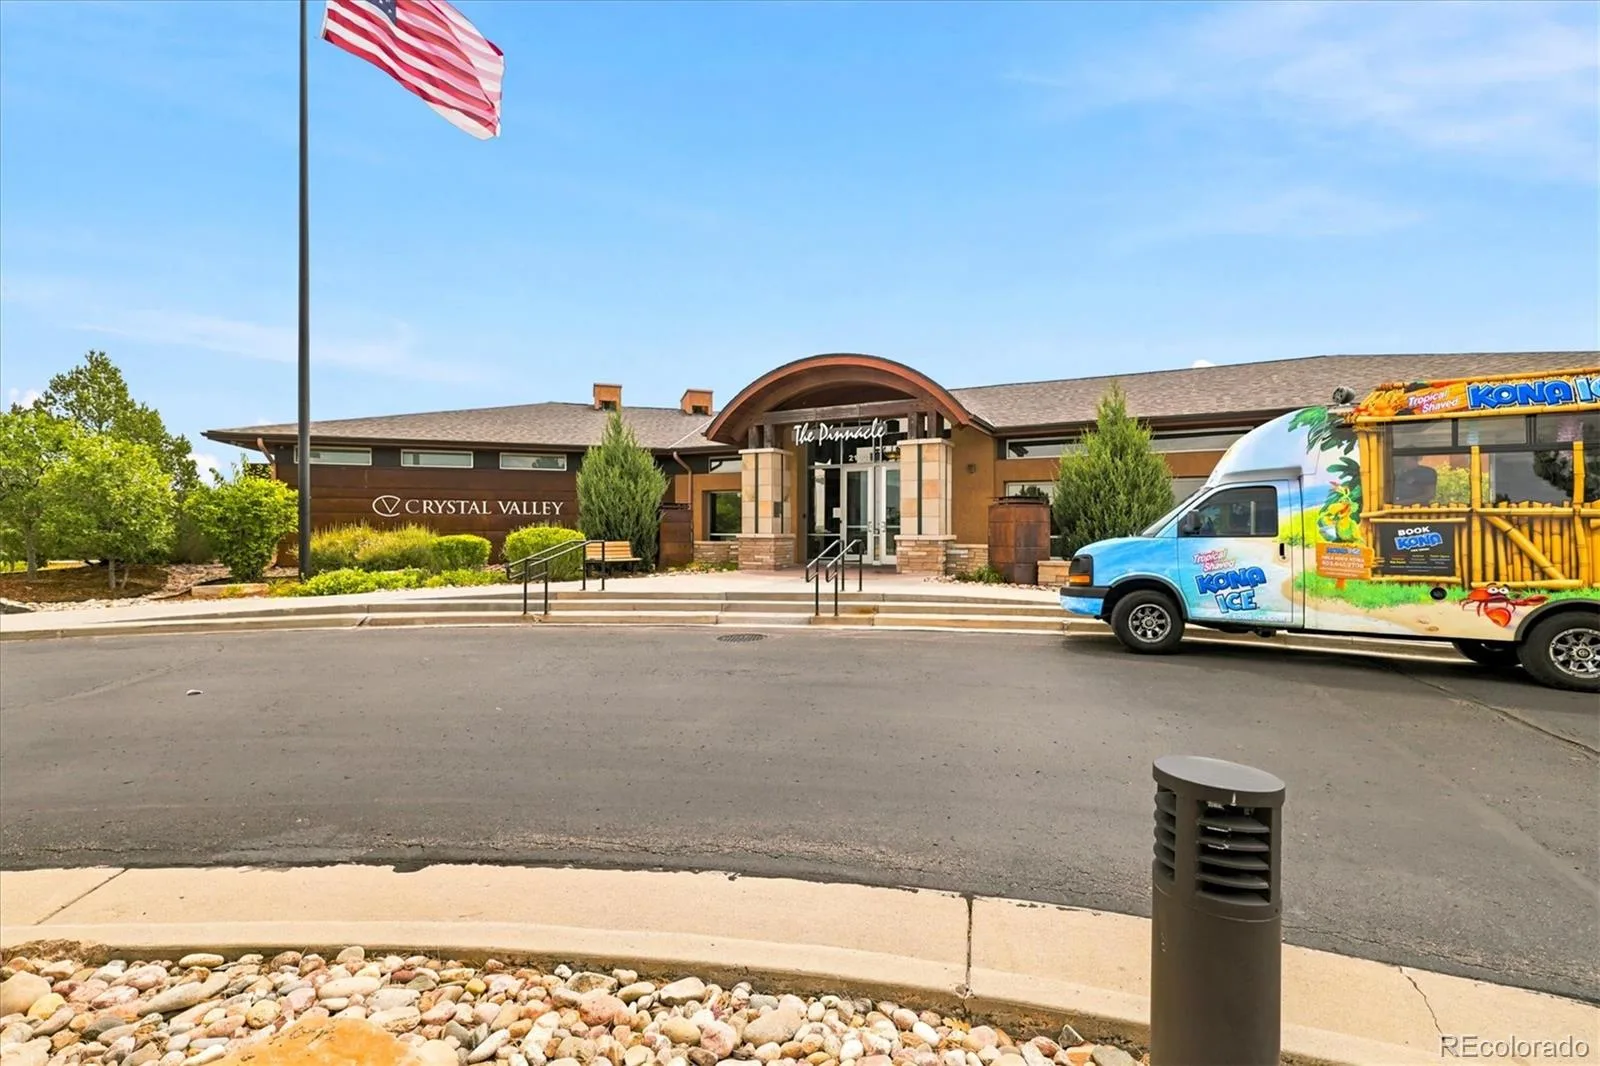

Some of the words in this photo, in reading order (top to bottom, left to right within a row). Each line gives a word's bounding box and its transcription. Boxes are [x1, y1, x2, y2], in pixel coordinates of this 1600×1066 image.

[1408, 389, 1448, 407] Tropical
[1466, 379, 1574, 410] KONA
[1421, 396, 1458, 413] Shaved
[793, 422, 815, 447] The
[818, 417, 886, 447] Pinnacle
[404, 499, 493, 515] CRYSTAL
[497, 500, 564, 515] VALLEY
[1397, 526, 1430, 536] BOOK
[1394, 532, 1443, 550] KONA
[1195, 566, 1267, 595] KONA
[1215, 589, 1257, 614] ICE
